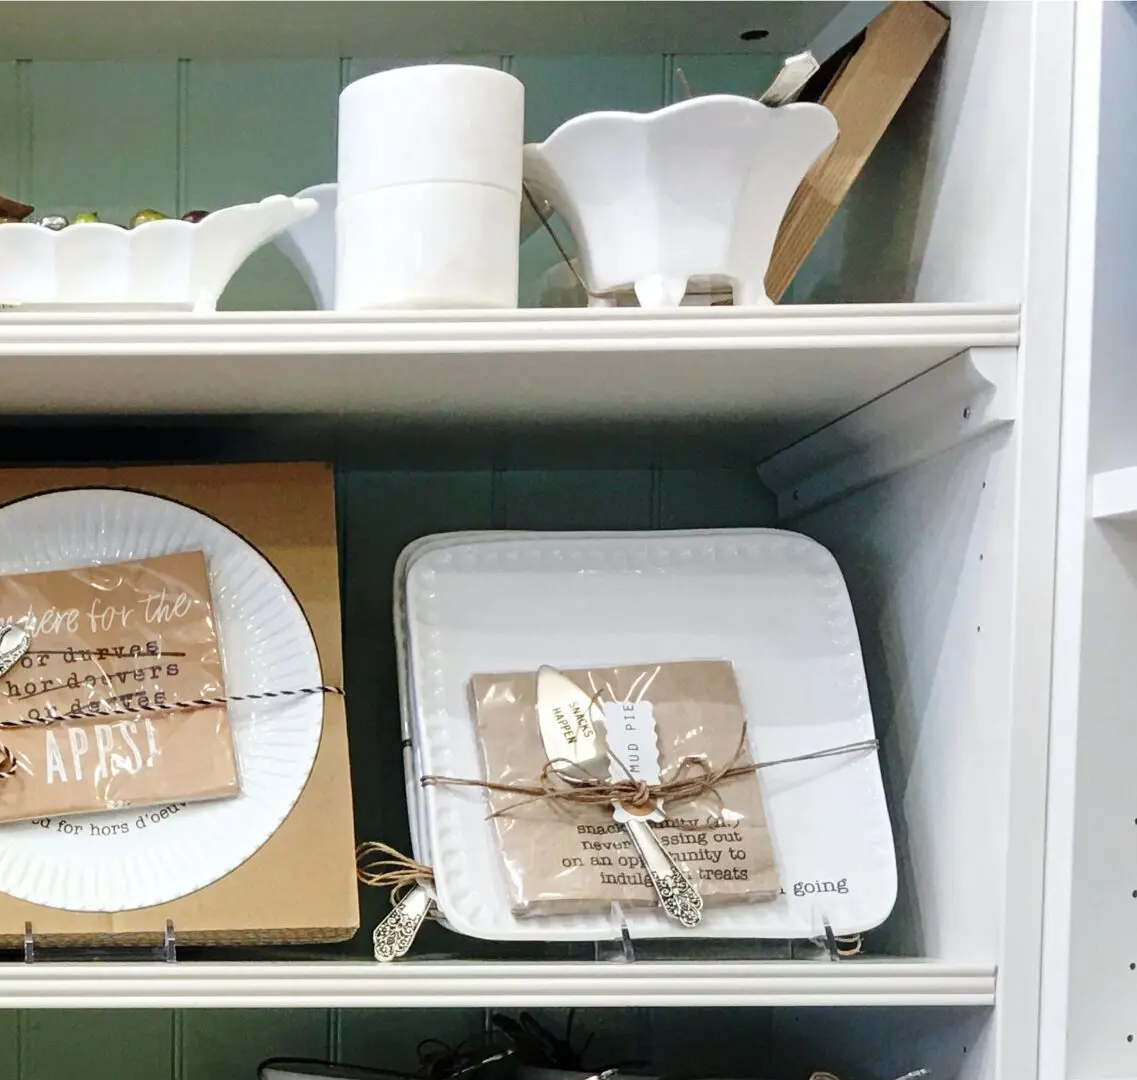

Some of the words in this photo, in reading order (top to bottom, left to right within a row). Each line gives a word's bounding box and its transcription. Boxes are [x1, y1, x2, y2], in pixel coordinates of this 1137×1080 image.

[87, 598, 134, 632] for
[137, 588, 192, 623] the
[7, 679, 54, 698] hor
[552, 707, 577, 745] HAPPEN
[568, 701, 594, 738] SNACKS
[623, 704, 637, 731] PIE
[627, 743, 640, 773] MUD
[57, 819, 84, 837] for
[90, 823, 130, 837] hors
[581, 839, 632, 851] never
[661, 832, 708, 846] ssing
[713, 831, 743, 843] out
[561, 856, 584, 868] on
[590, 855, 616, 867] an
[729, 847, 746, 860] to
[600, 871, 653, 888] indulg
[698, 867, 749, 881] treats
[793, 878, 850, 897] going
